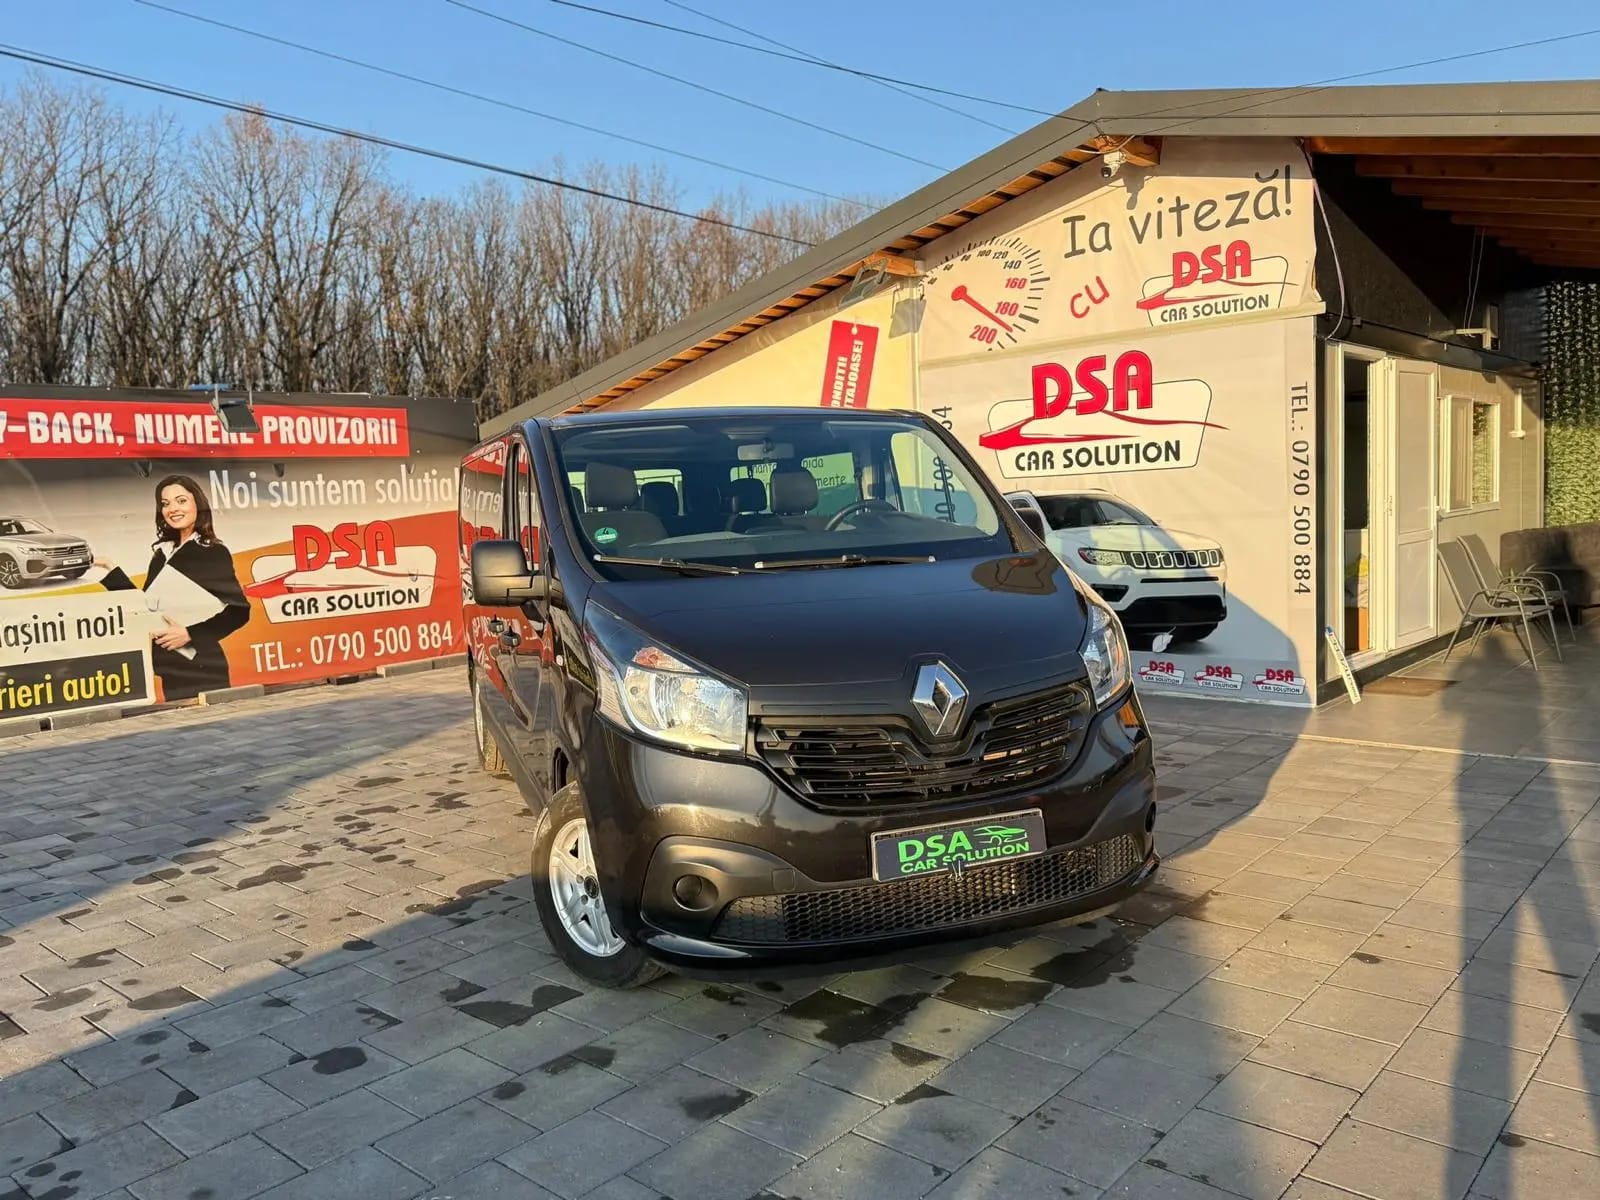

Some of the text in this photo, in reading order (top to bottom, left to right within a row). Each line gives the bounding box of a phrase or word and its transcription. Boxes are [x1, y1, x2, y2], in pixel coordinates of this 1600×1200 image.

[1062, 164, 1292, 259] Ia viteză!
[992, 251, 1009, 259] 120
[1003, 260, 1022, 270] 140
[1172, 239, 1252, 289] DSA
[1004, 277, 1028, 290] 160
[1069, 275, 1111, 319] cu
[995, 301, 1020, 317] 180
[1160, 294, 1270, 323] CAR SOLUTION
[969, 324, 998, 345] 200
[1032, 350, 1153, 420] DSA
[262, 415, 398, 445] PROVIZORII
[1015, 439, 1181, 472] CAR SOLUTION
[208, 469, 259, 510] Noi
[267, 473, 366, 508] suntem
[1291, 381, 1311, 595] TEL.: 0790 500 884
[292, 520, 397, 572] DSA
[281, 588, 420, 616] CAR SOLUTION
[0, 605, 125, 653] așini noi!
[250, 642, 304, 673] TEL.:
[310, 631, 365, 665] 0790
[374, 626, 411, 656] 500
[418, 620, 453, 650] 884
[62, 662, 131, 702] auto!
[1149, 660, 1175, 674] DSA
[1206, 665, 1232, 678] DSA
[1265, 668, 1294, 682] DSA
[897, 830, 973, 863] DSA
[901, 841, 1030, 873] CAR SOLUTION
